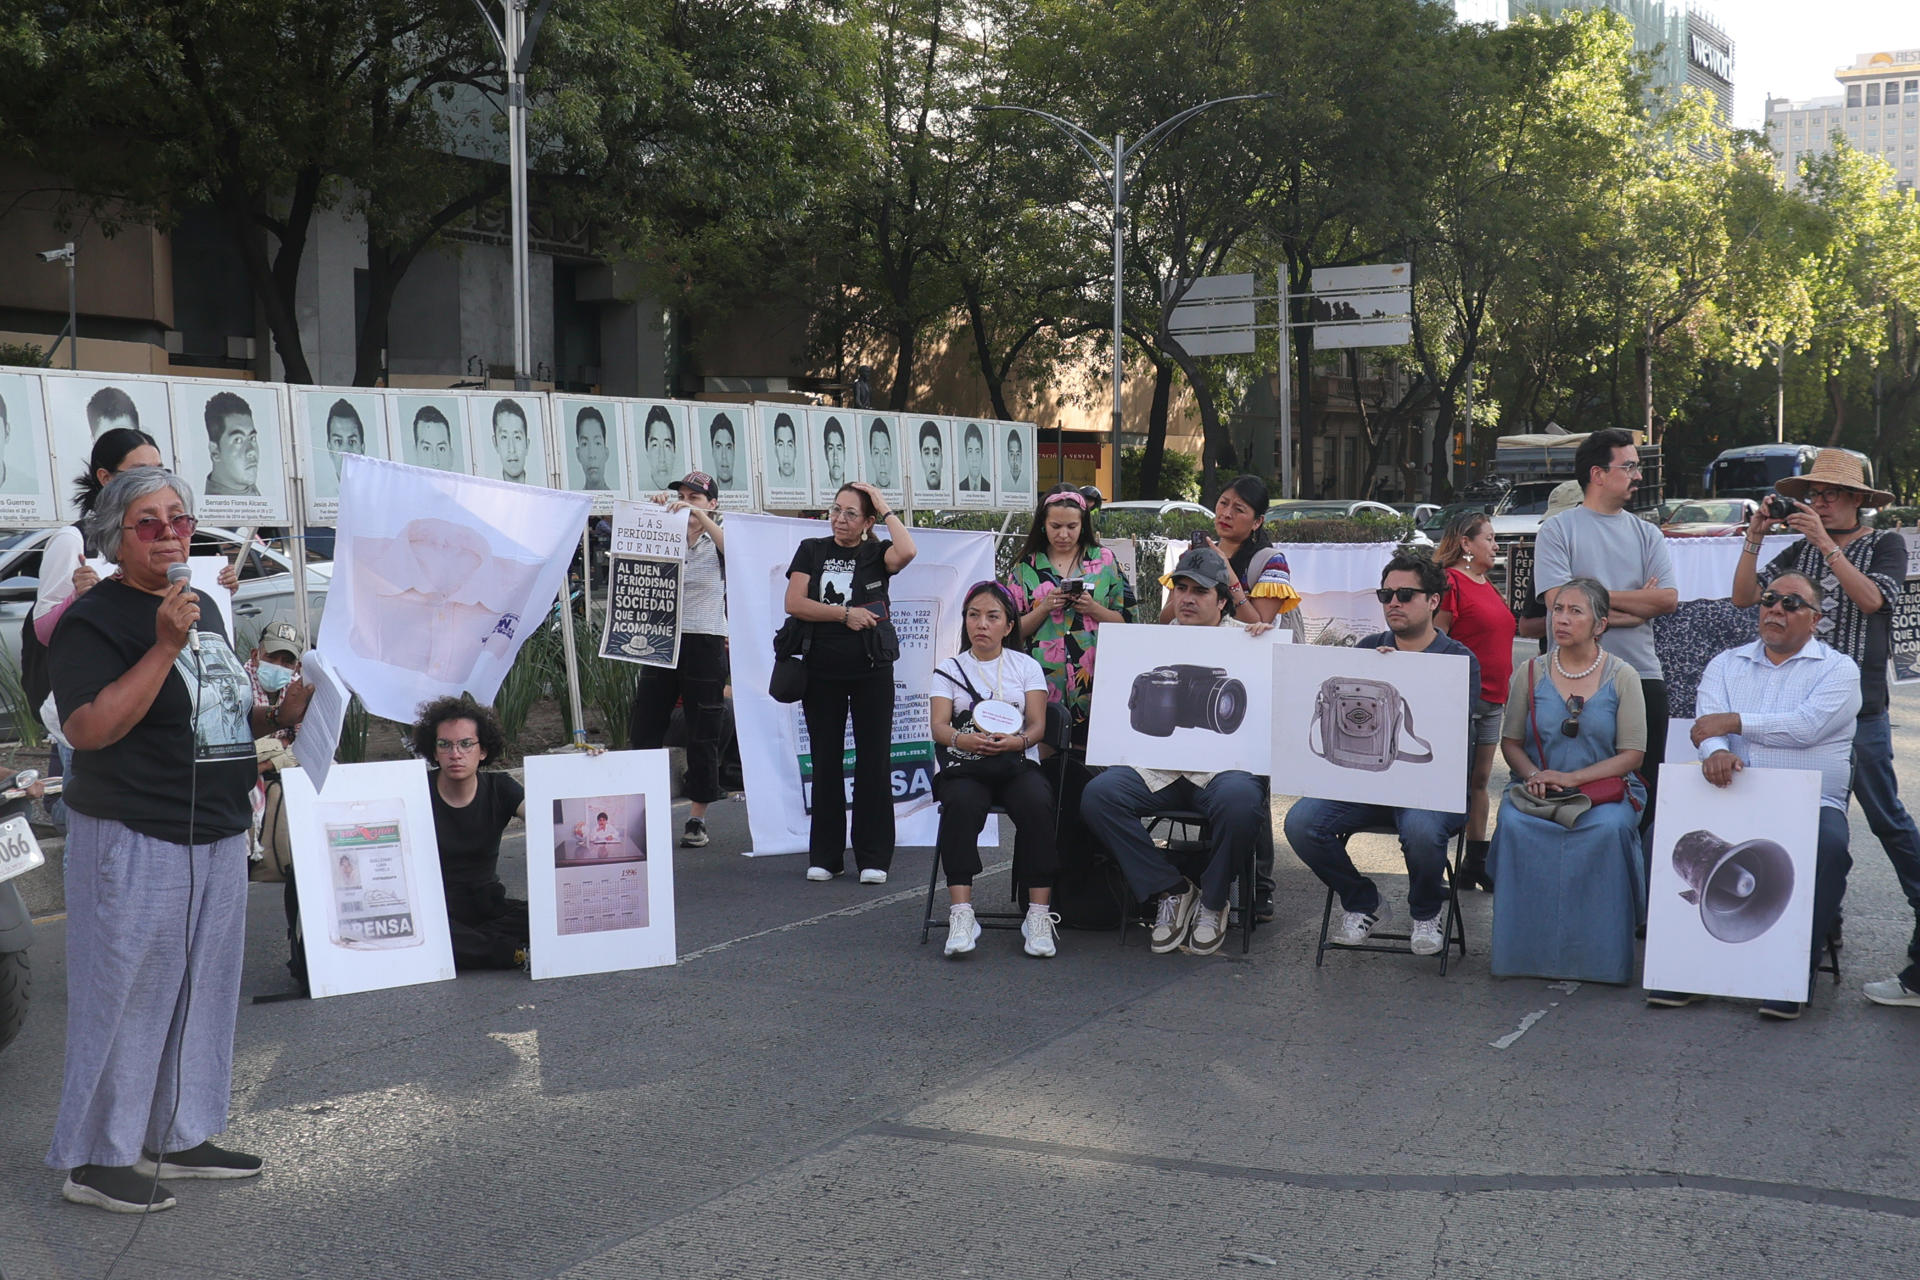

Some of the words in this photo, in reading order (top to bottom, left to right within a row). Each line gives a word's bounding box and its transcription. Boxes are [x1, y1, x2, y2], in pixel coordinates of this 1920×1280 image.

[637, 517, 662, 529] LAS
[617, 528, 682, 543] PERIODISTAS
[616, 540, 680, 556] CUENTAN
[617, 562, 630, 573] AL
[633, 563, 660, 577] BUEN
[617, 573, 676, 590] PERIODISMO
[615, 585, 626, 595] LE
[627, 586, 650, 597] HACE
[651, 588, 675, 600] FALTA
[615, 595, 675, 613] SOCIEDAD
[614, 609, 634, 621] QUE
[636, 611, 648, 622] LO
[612, 621, 674, 637] ACOMPAÑE
[1893, 629, 1914, 642] QUE
[904, 693, 929, 701] FEDERALES
[898, 732, 929, 740] MEXICANA
[341, 918, 412, 938] RENSA
